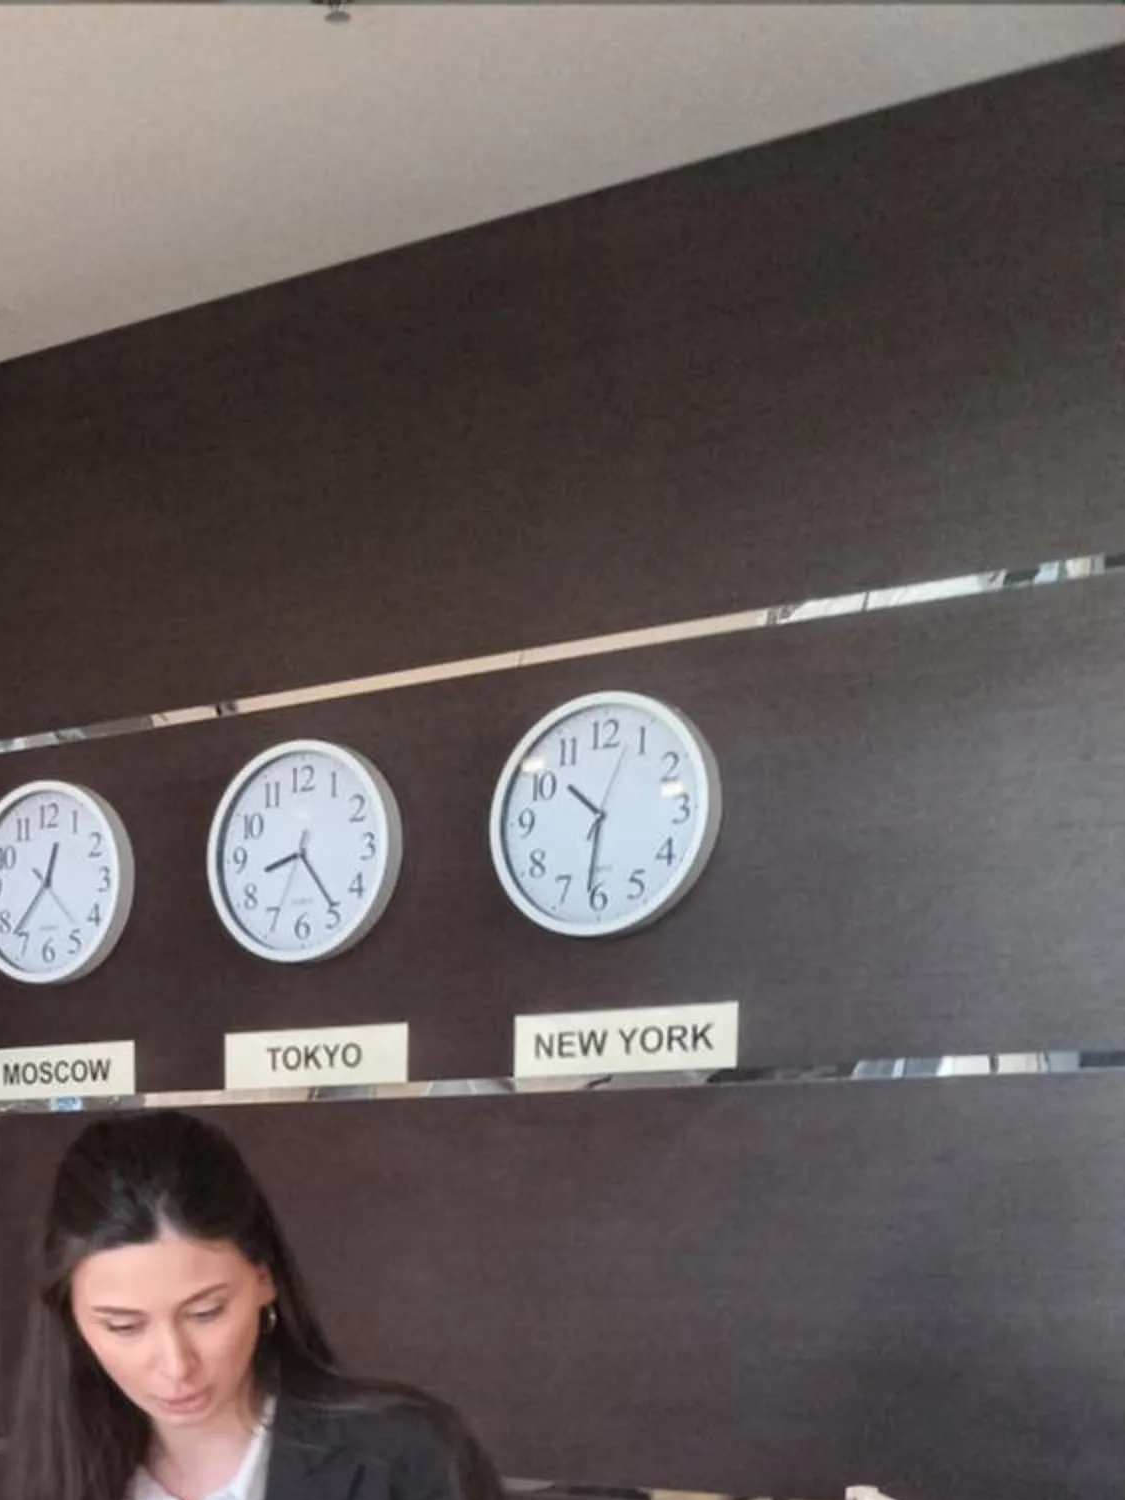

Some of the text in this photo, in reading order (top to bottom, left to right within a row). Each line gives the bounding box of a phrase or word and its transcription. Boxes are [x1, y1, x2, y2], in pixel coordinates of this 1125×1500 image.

[592, 719, 620, 750] 12
[560, 737, 577, 766] 11
[292, 765, 315, 793] 12
[660, 752, 680, 783] 2
[265, 782, 280, 808] 11
[533, 771, 557, 801] 10
[40, 803, 59, 829] 12
[349, 794, 365, 822] 2
[673, 794, 690, 824] 3
[16, 818, 30, 841] 11
[244, 813, 264, 840] 10
[519, 808, 535, 838] 9
[89, 832, 102, 858] 2
[361, 832, 375, 860] 3
[655, 837, 675, 866] 4
[233, 847, 247, 874] 9
[529, 849, 546, 878] 8
[98, 866, 110, 892] 3
[348, 872, 364, 898] 4
[556, 875, 571, 903] 7
[628, 869, 646, 899] 5
[244, 883, 258, 910] 8
[589, 882, 608, 911] 6
[0, 909, 11, 934] 8
[87, 903, 101, 927] 4
[266, 907, 280, 932] 7
[294, 913, 311, 939] 6
[326, 902, 341, 929] 5
[18, 931, 29, 957] 7
[42, 937, 55, 963] 6
[69, 928, 81, 954] 5
[534, 1022, 714, 1060] NEW YORK
[267, 1042, 362, 1072] TOKYO
[2, 1058, 111, 1086] MOSCOW
